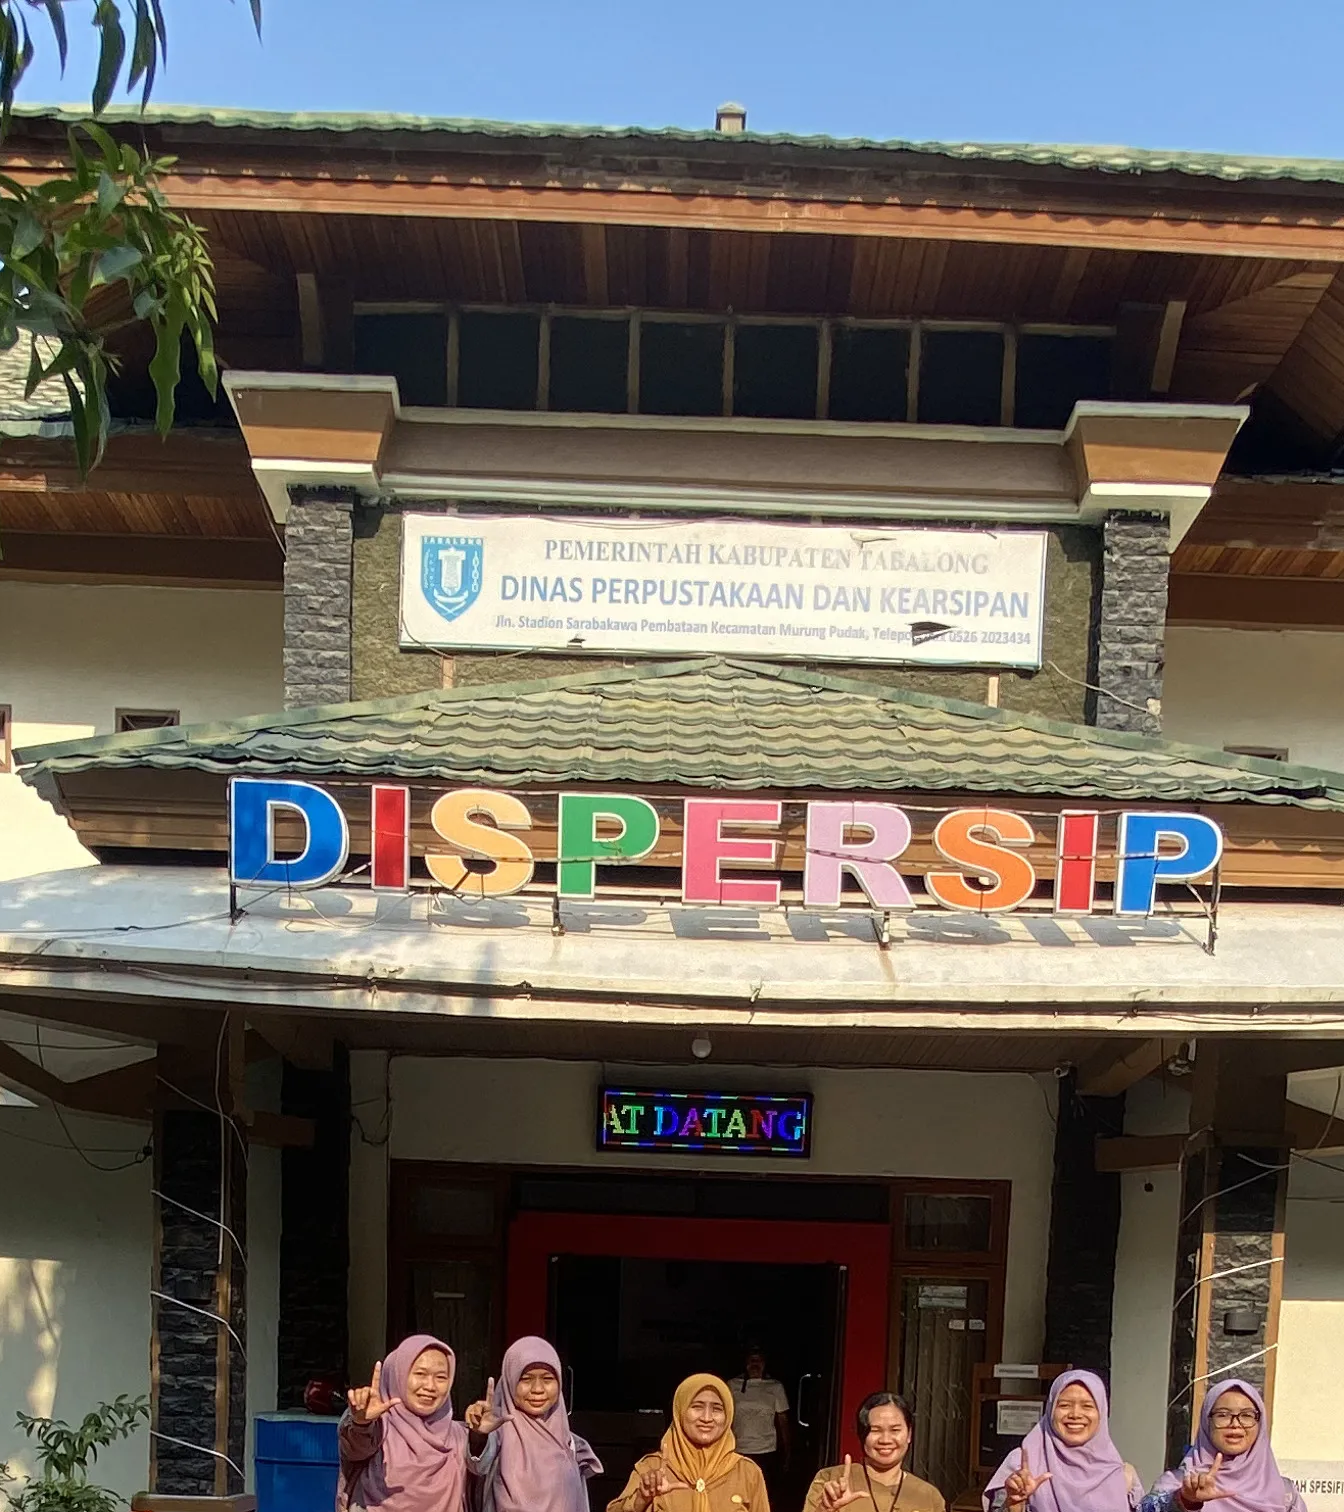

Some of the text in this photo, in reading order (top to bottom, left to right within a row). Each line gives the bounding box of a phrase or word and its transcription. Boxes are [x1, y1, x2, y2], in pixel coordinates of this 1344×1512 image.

[545, 539, 989, 574] PEMERINTAH KABUPATEN TABALONG
[501, 575, 1030, 618] DINAS PERPUSTAKAAN DAN KEARSIPAN
[495, 615, 516, 628] Jln.
[518, 615, 563, 629] Stadion
[566, 617, 637, 632] Sarabakawa
[640, 619, 708, 634] Pembataan
[711, 621, 776, 636] Kecamatan
[779, 623, 826, 640] Murung
[829, 625, 869, 641] Pudak,
[981, 631, 1031, 645] 2023434
[229, 777, 1224, 916] DISPERSIP
[653, 1105, 805, 1140] DATANG
